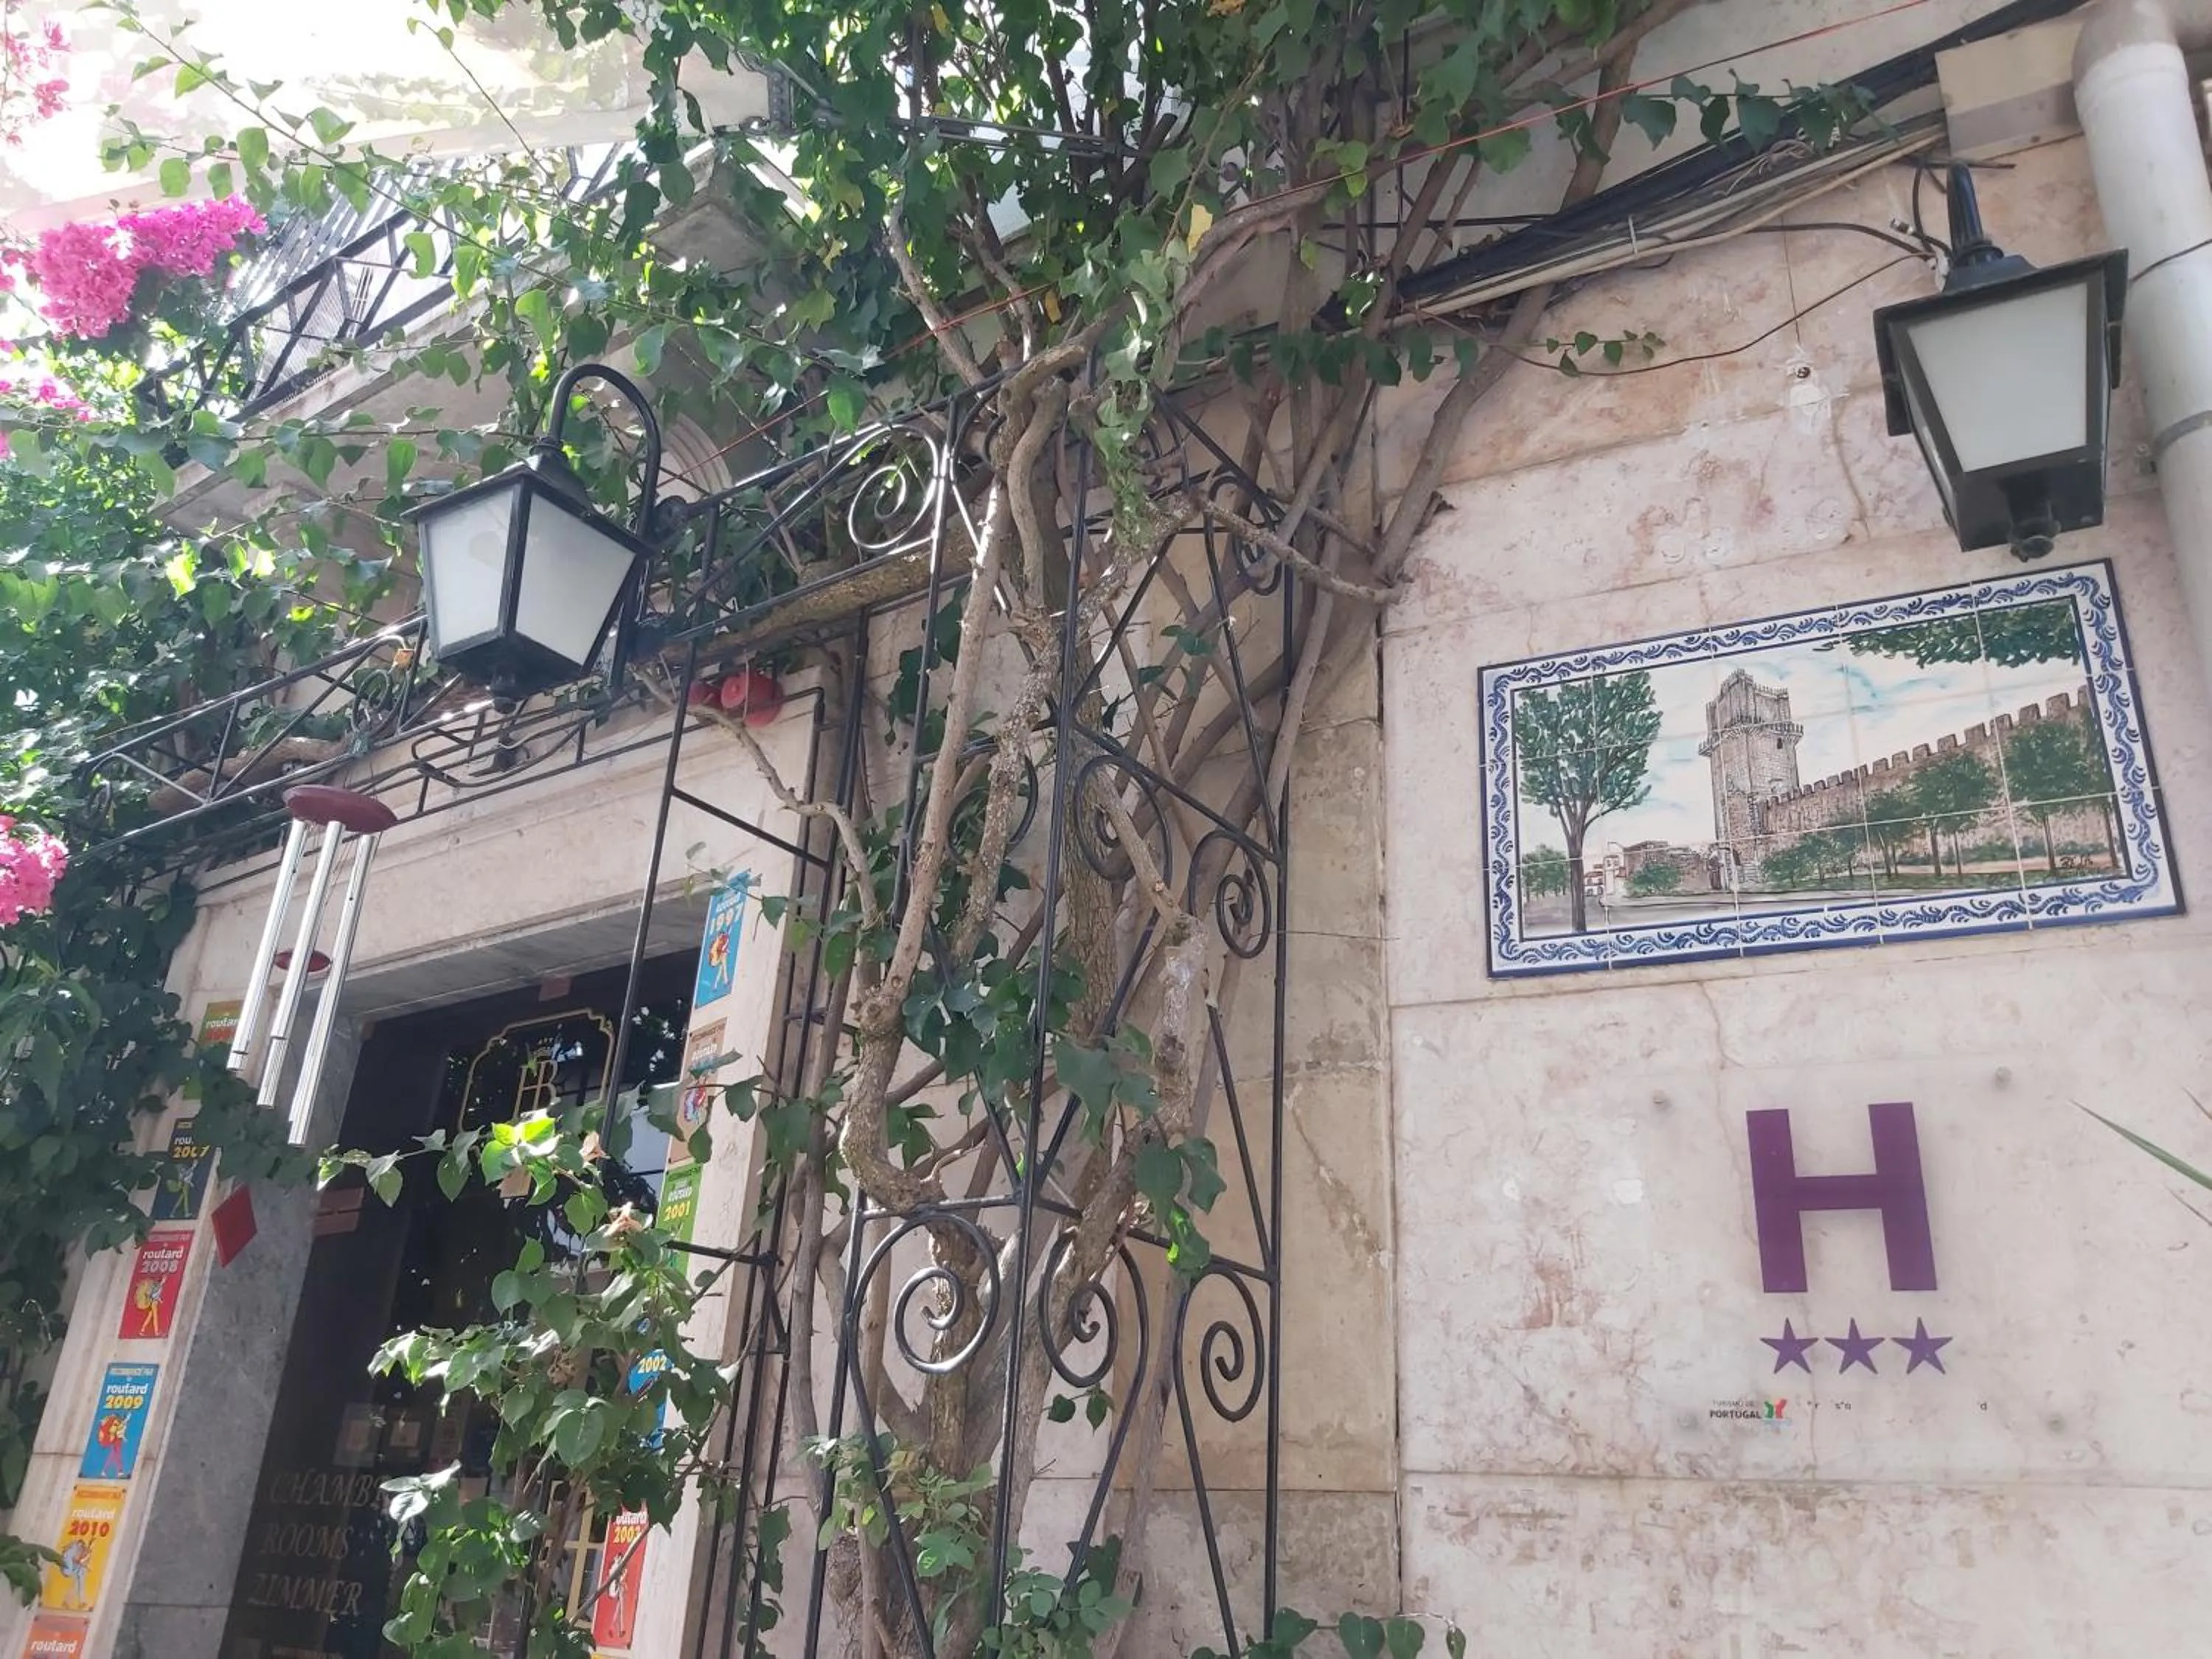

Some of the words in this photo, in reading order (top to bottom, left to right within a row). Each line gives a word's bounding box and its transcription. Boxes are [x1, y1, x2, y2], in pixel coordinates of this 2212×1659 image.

[206, 1018, 240, 1029] routar
[1746, 1102, 1938, 1293] H
[664, 1200, 691, 1222] 2001
[142, 1246, 184, 1259] routard
[141, 1259, 178, 1273] 2008
[637, 1354, 667, 1374] 2002
[106, 1383, 148, 1394] routard
[103, 1394, 143, 1409] 2009
[1709, 1409, 1762, 1419] PORTUGAL
[72, 1508, 116, 1519] routard
[613, 1509, 647, 1525] outard
[68, 1520, 110, 1537] 2010
[260, 1523, 354, 1560] ROOMS
[248, 1573, 363, 1617] ZIMMER
[30, 1640, 77, 1653] routard
